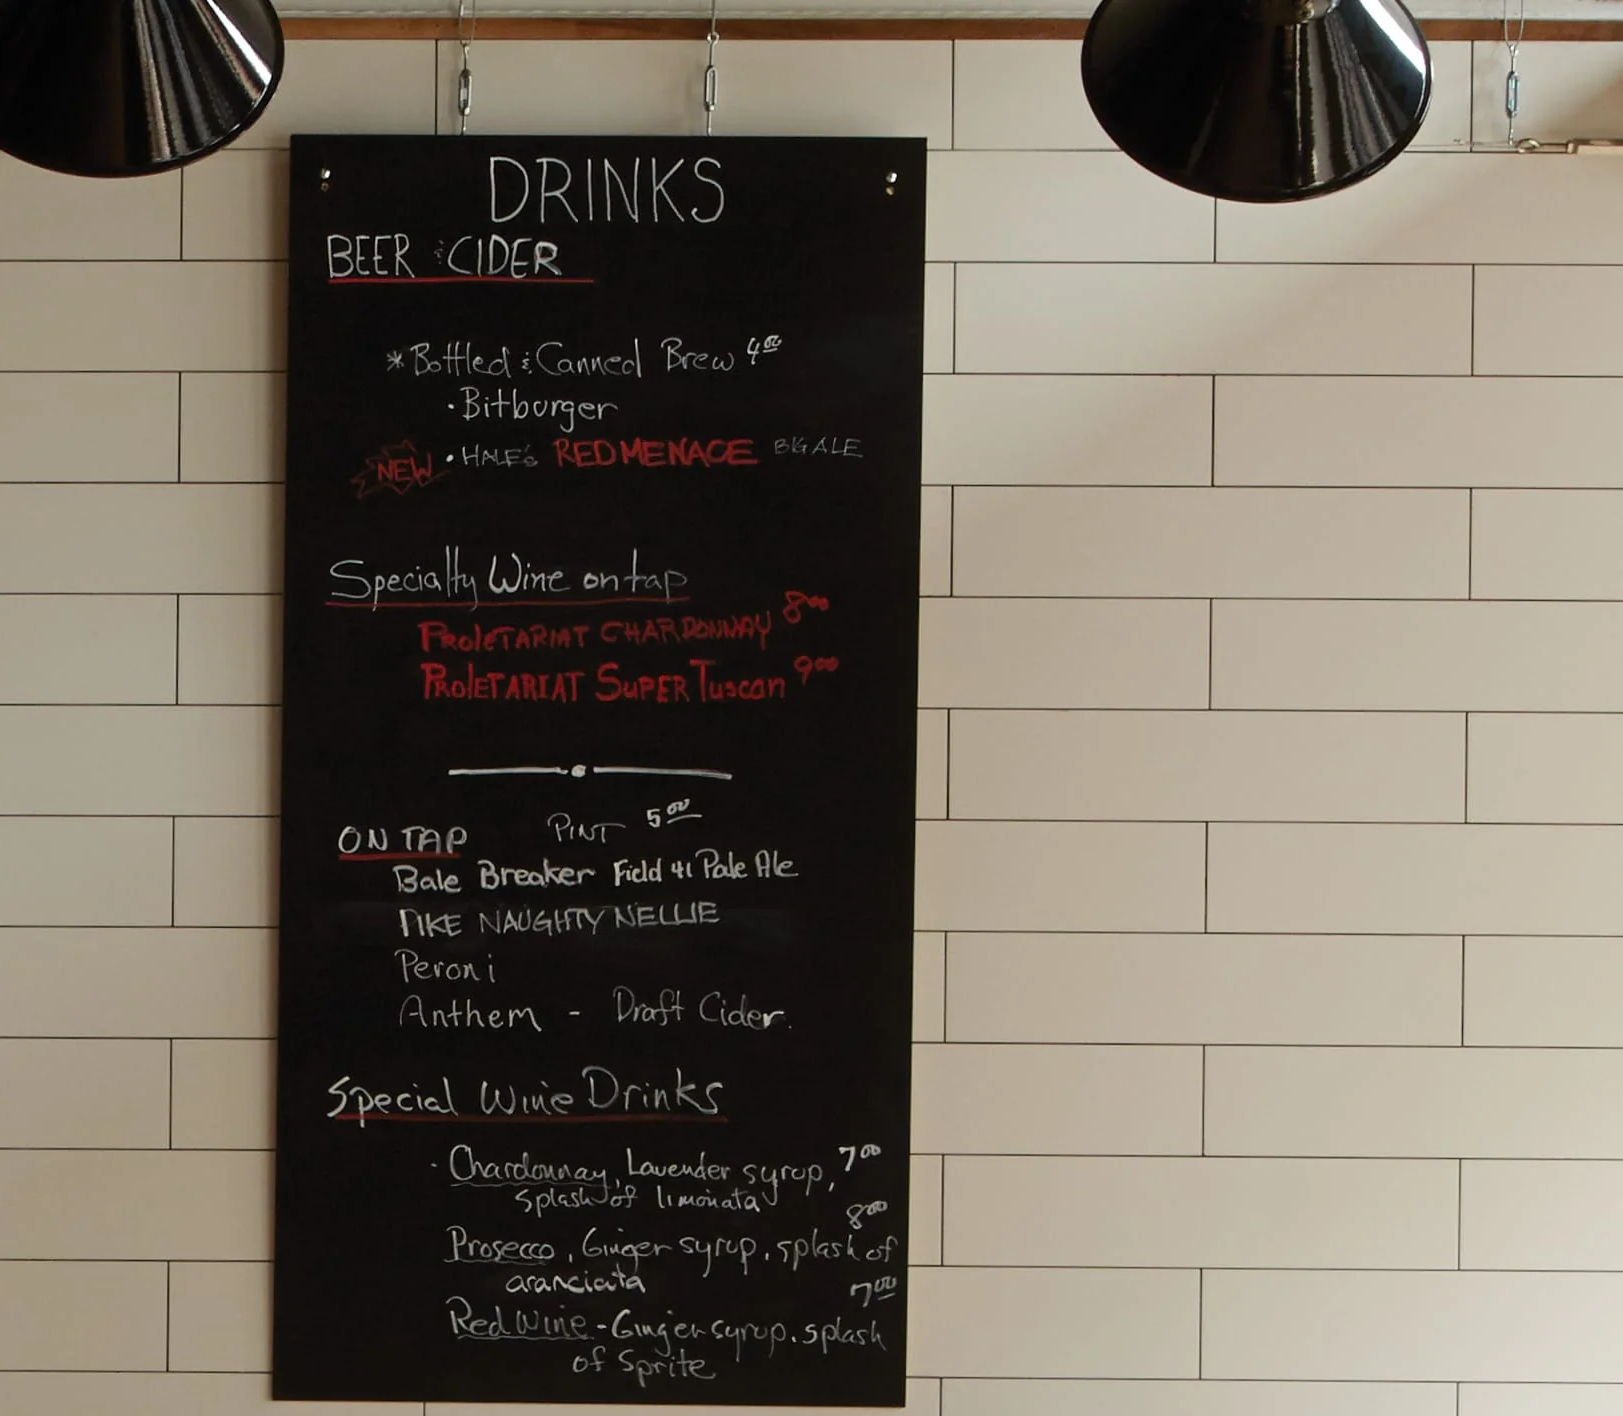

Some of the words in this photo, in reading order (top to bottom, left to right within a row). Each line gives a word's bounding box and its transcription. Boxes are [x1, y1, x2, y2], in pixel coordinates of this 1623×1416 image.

[488, 154, 726, 224] DRINKS
[325, 232, 417, 280] BEER
[446, 233, 563, 280] CIDER
[410, 340, 513, 380] Bottled
[535, 340, 642, 380] Canned
[659, 335, 736, 373] Brew
[459, 385, 620, 434] Bitburger
[377, 450, 433, 482] NEW
[552, 436, 617, 469] RED
[619, 436, 761, 468] MENACE
[328, 544, 479, 613] Specialty
[487, 551, 571, 596] Wine
[582, 571, 620, 594] on
[622, 547, 689, 605] tap
[688, 657, 786, 703] Tuscan
[337, 825, 389, 855] ON
[400, 824, 469, 857] TAP
[546, 810, 627, 846] PINT
[391, 862, 463, 894] Bale
[477, 857, 597, 891] Breaker
[611, 856, 663, 889] Field
[670, 858, 694, 882] 41
[694, 847, 749, 881] Pale
[754, 848, 800, 879] Ale
[398, 907, 463, 938] PIKE
[479, 906, 618, 937] NAUGHTY
[612, 899, 722, 930] NELLIE
[394, 947, 497, 985] Peroni
[398, 993, 543, 1033] Anthem
[611, 984, 686, 1027] Draft
[326, 1074, 460, 1130] Special
[480, 1079, 575, 1117] Wine
[581, 1064, 724, 1115] Drinks
[625, 1146, 732, 1180] Lavender
[514, 1186, 596, 1219] splash
[608, 1184, 638, 1209] of
[656, 1183, 762, 1214] limonata
[581, 1225, 674, 1275] Ginger
[776, 1227, 862, 1272] splash
[864, 1234, 899, 1264] of
[504, 1260, 647, 1296] aranciata
[444, 1294, 512, 1337] Red
[515, 1303, 591, 1338] Wine
[611, 1308, 707, 1358] Ginger
[802, 1316, 887, 1355] splash
[572, 1345, 606, 1373] of
[617, 1347, 718, 1388] Sprite
